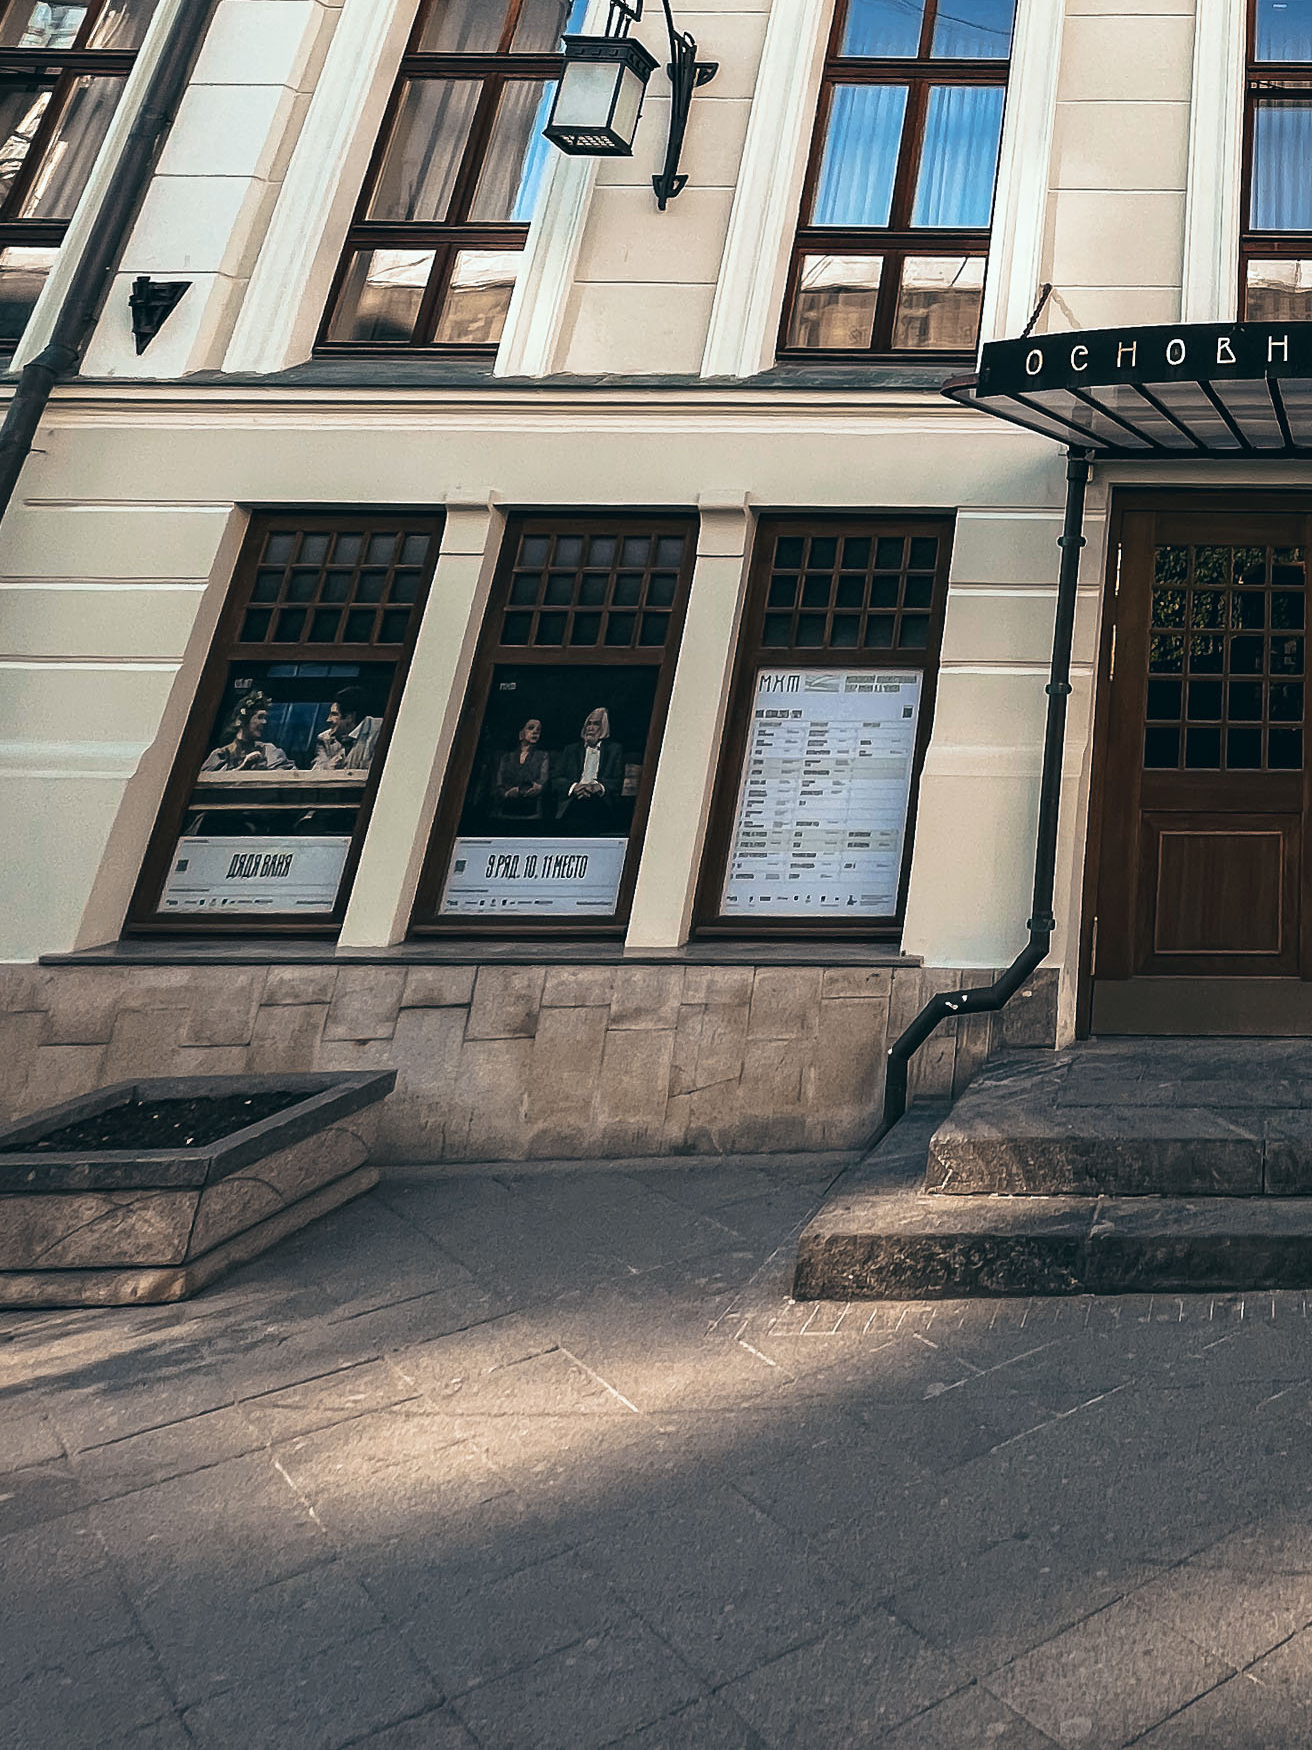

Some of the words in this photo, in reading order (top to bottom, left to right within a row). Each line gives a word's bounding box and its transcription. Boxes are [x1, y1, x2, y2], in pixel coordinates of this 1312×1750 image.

[226, 853, 262, 879] ДЯДЯ
[259, 853, 294, 878] ВАНЯ
[485, 854, 495, 878] 9
[541, 855, 553, 879] 11
[552, 855, 589, 879] МЕСТО
